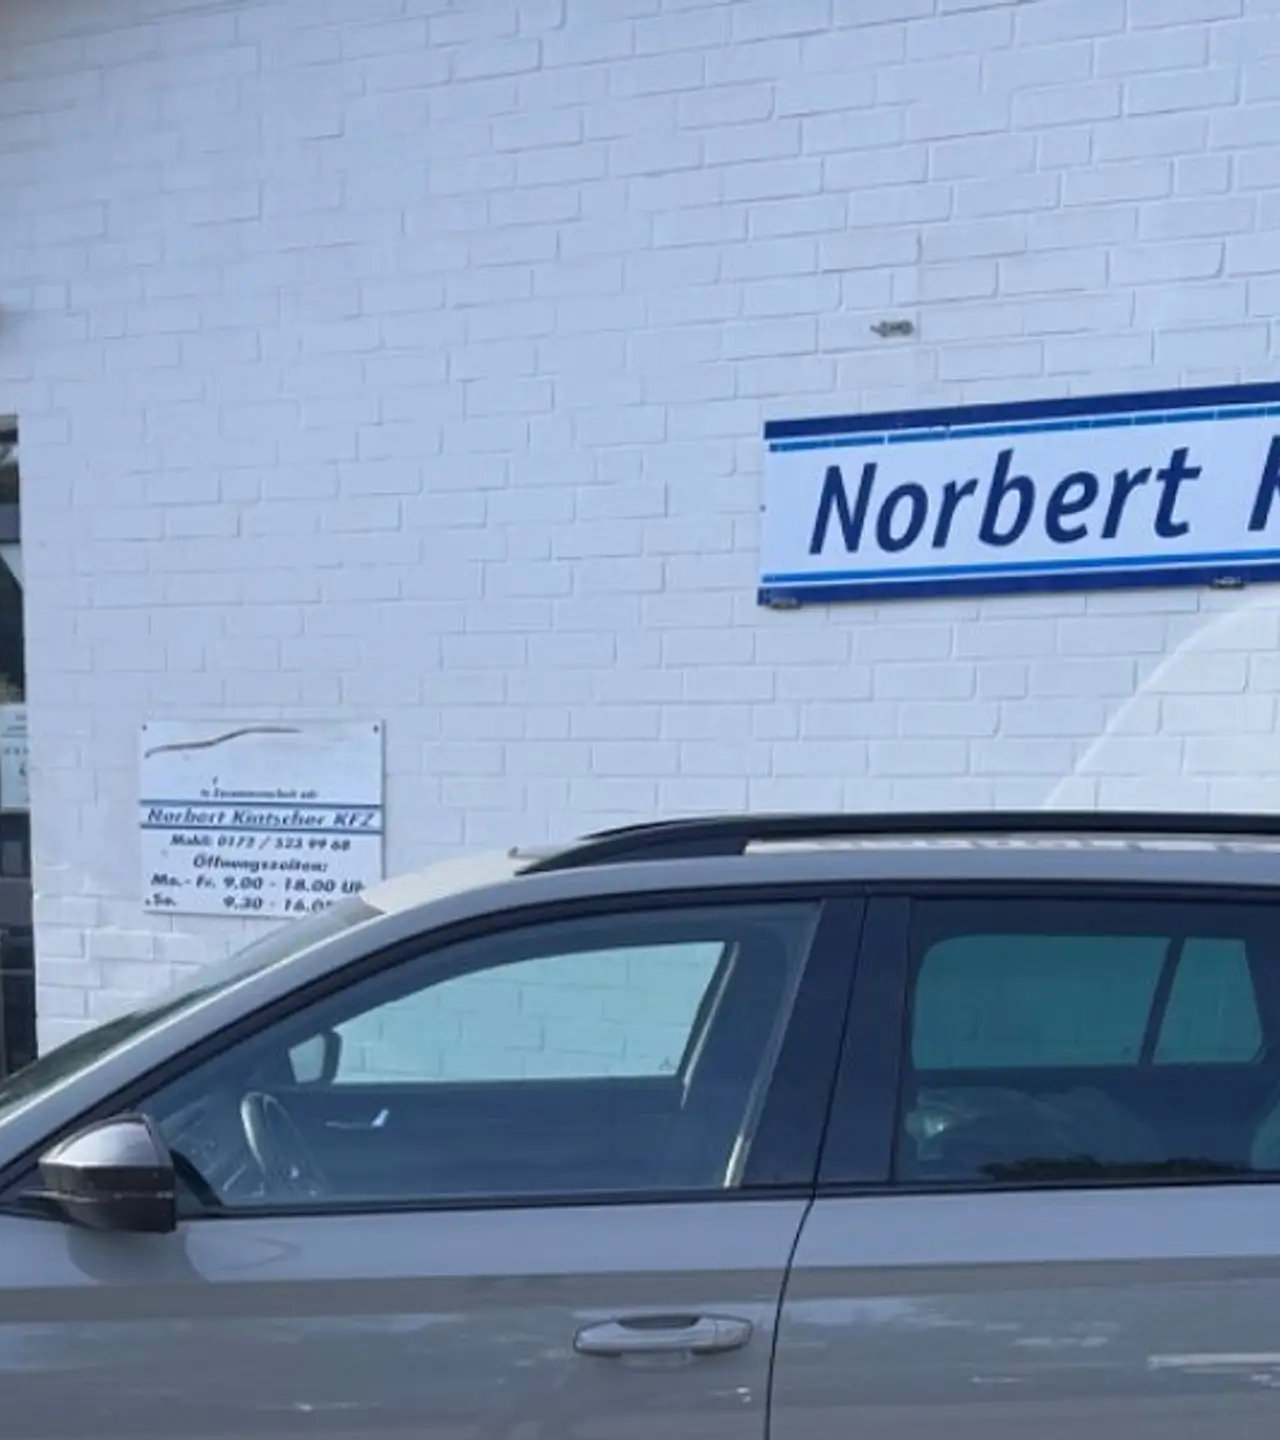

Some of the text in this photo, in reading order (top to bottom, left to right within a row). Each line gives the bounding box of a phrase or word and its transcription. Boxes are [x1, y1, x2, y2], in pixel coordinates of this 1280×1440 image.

[808, 446, 1203, 555] Norbert
[148, 806, 377, 827] Norbert Kintscher KFZ
